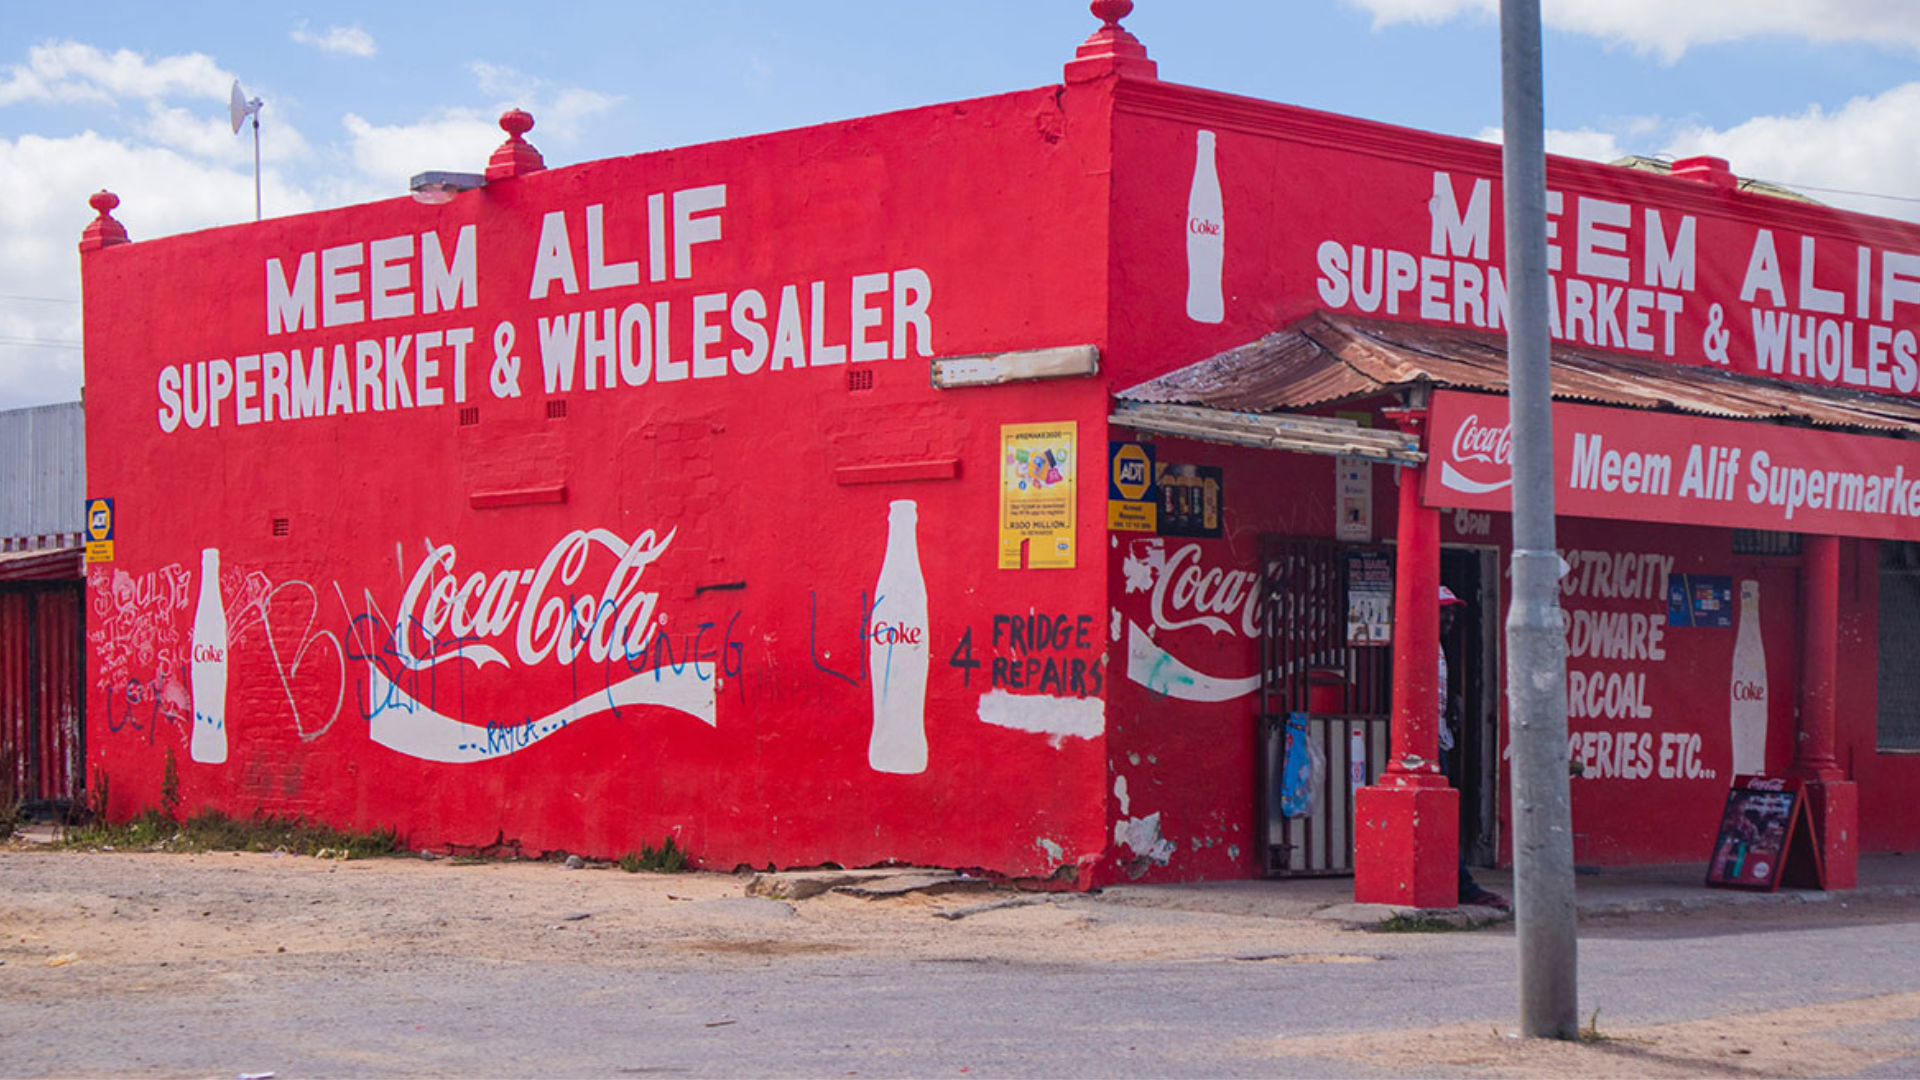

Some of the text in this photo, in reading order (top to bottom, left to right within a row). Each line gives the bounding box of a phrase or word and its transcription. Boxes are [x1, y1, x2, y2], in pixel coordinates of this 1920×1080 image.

[1190, 217, 1220, 236] Coke
[266, 184, 727, 335] MEEM ALIF
[1740, 228, 1920, 321] ALIF
[158, 268, 934, 434] SUPERMARKET & WHOLESALER
[1703, 303, 1729, 365] &
[1120, 462, 1144, 481] ADT
[1570, 433, 1671, 496] Meem
[1679, 444, 1739, 502] Alif
[1747, 450, 1920, 520] Supermarke
[397, 526, 677, 670] Coca-Cola
[1557, 549, 1674, 600] CTRICITY
[194, 644, 224, 663] Coke
[874, 622, 921, 645] Coke
[950, 613, 1092, 689] 4 FRIDGE
[992, 657, 1102, 697] REPAIRS
[1568, 671, 1652, 719] RCOAL
[1733, 681, 1764, 701] Coke
[1569, 732, 1653, 779] CERIES
